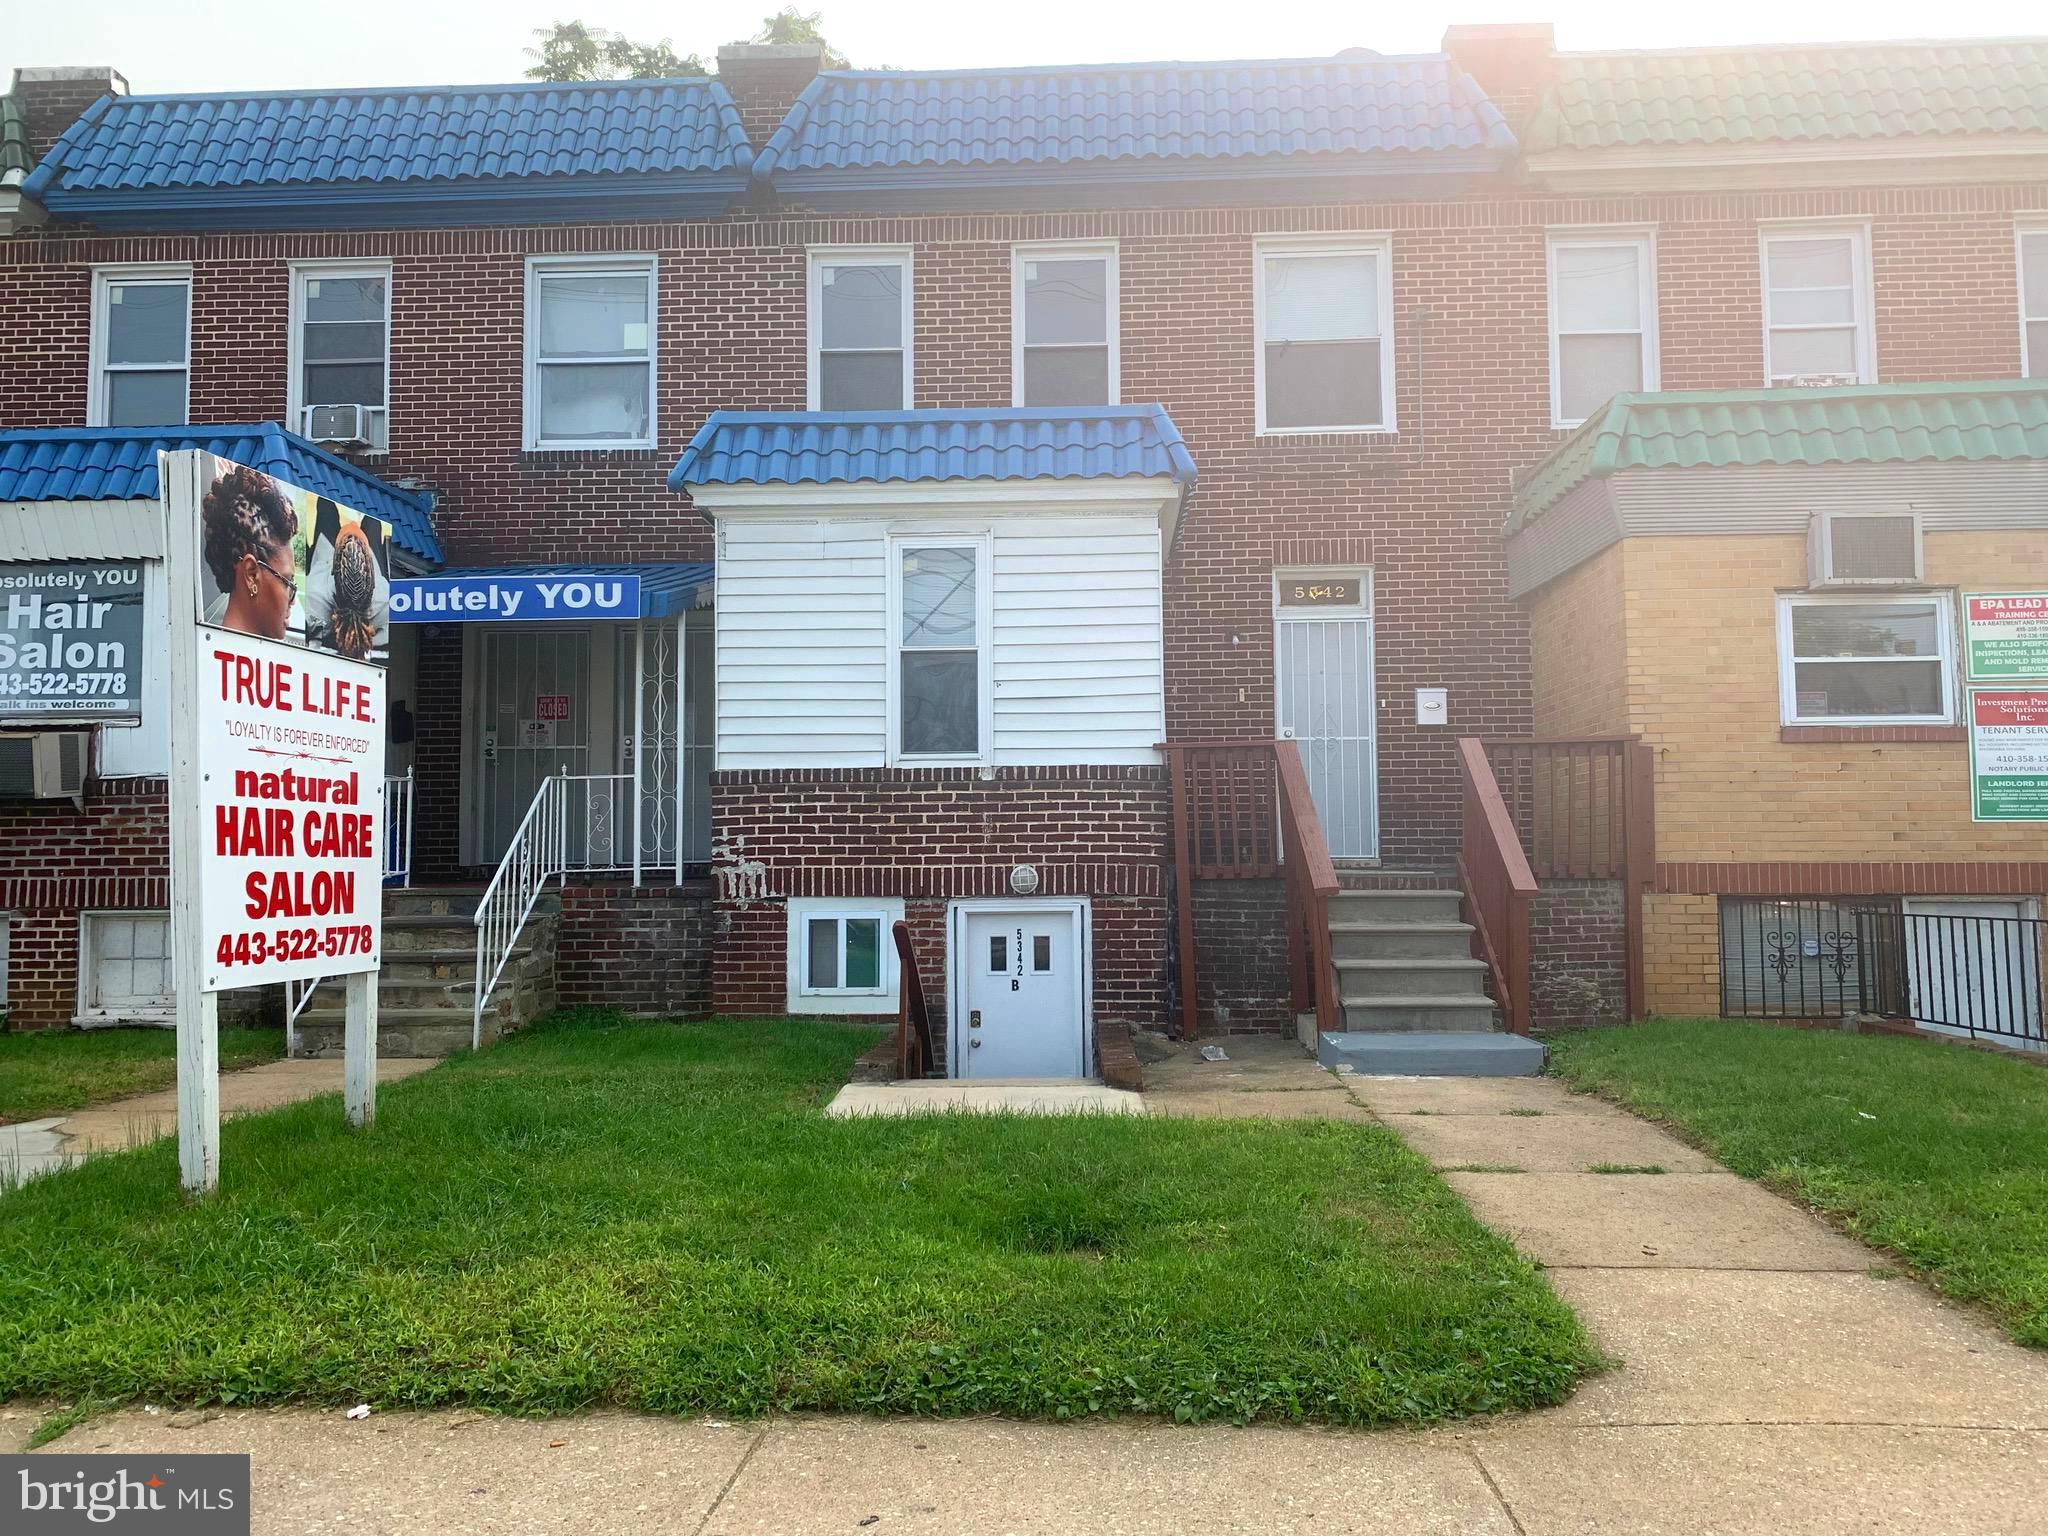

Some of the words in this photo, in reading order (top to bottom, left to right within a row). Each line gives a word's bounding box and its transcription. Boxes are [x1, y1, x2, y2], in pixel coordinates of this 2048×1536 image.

[0, 571, 87, 590] solutely
[92, 569, 138, 585] YOU
[7, 593, 113, 630] Hair
[388, 584, 523, 617] olutely
[535, 582, 622, 609] YOU
[1980, 600, 2005, 610] EPA
[2008, 599, 2042, 609] LEAD
[1994, 611, 2037, 619] TRAINING
[0, 633, 125, 669] Salon
[2017, 665, 2048, 673] SERVIC
[213, 650, 293, 712] TRUE
[302, 672, 376, 724] L.I.F.E.
[26, 700, 47, 709] ins
[51, 700, 116, 709] welcome
[1977, 698, 2029, 706] Investment
[2031, 697, 2048, 706] Pro
[2000, 705, 2048, 713] Solutions
[2016, 713, 2036, 721] Inc.
[225, 719, 272, 742] "LOYALTY
[273, 726, 282, 743] IS
[284, 727, 324, 748] FOREVER
[325, 734, 370, 754] ENFORCED"
[235, 767, 359, 805] natural
[216, 805, 295, 857] HAIR
[302, 810, 373, 858] CARE
[245, 870, 355, 920] SALON
[216, 925, 373, 968] 443-522-5778
[1011, 979, 1020, 992] B
